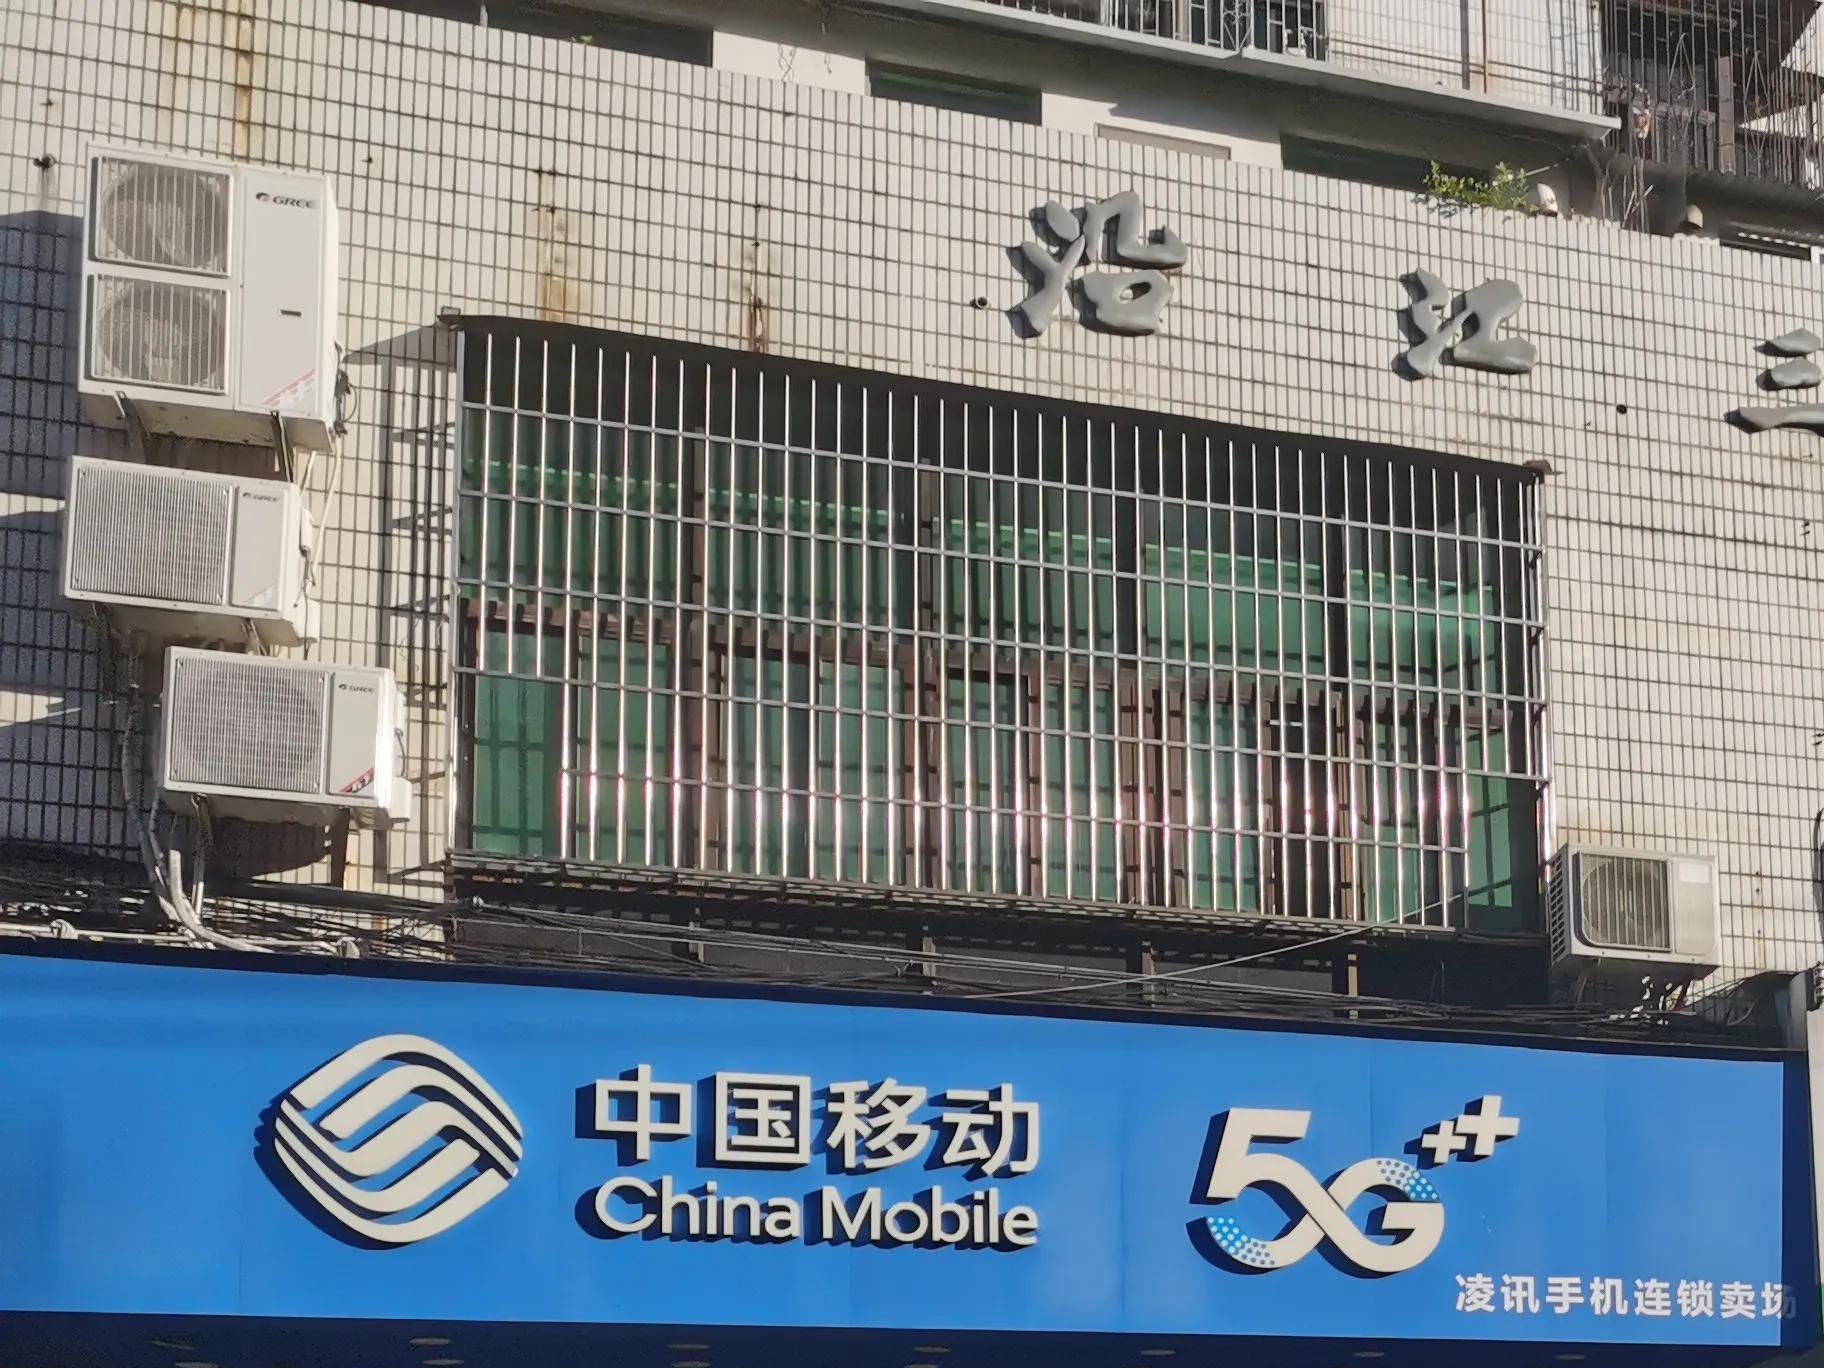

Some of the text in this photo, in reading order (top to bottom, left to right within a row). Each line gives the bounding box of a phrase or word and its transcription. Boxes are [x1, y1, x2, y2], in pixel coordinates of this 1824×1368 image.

[594, 1064, 1041, 1177] 中国移动
[594, 1175, 1040, 1246] China Mobile
[1455, 1273, 1796, 1321] 凌讯手机连锁卖场
